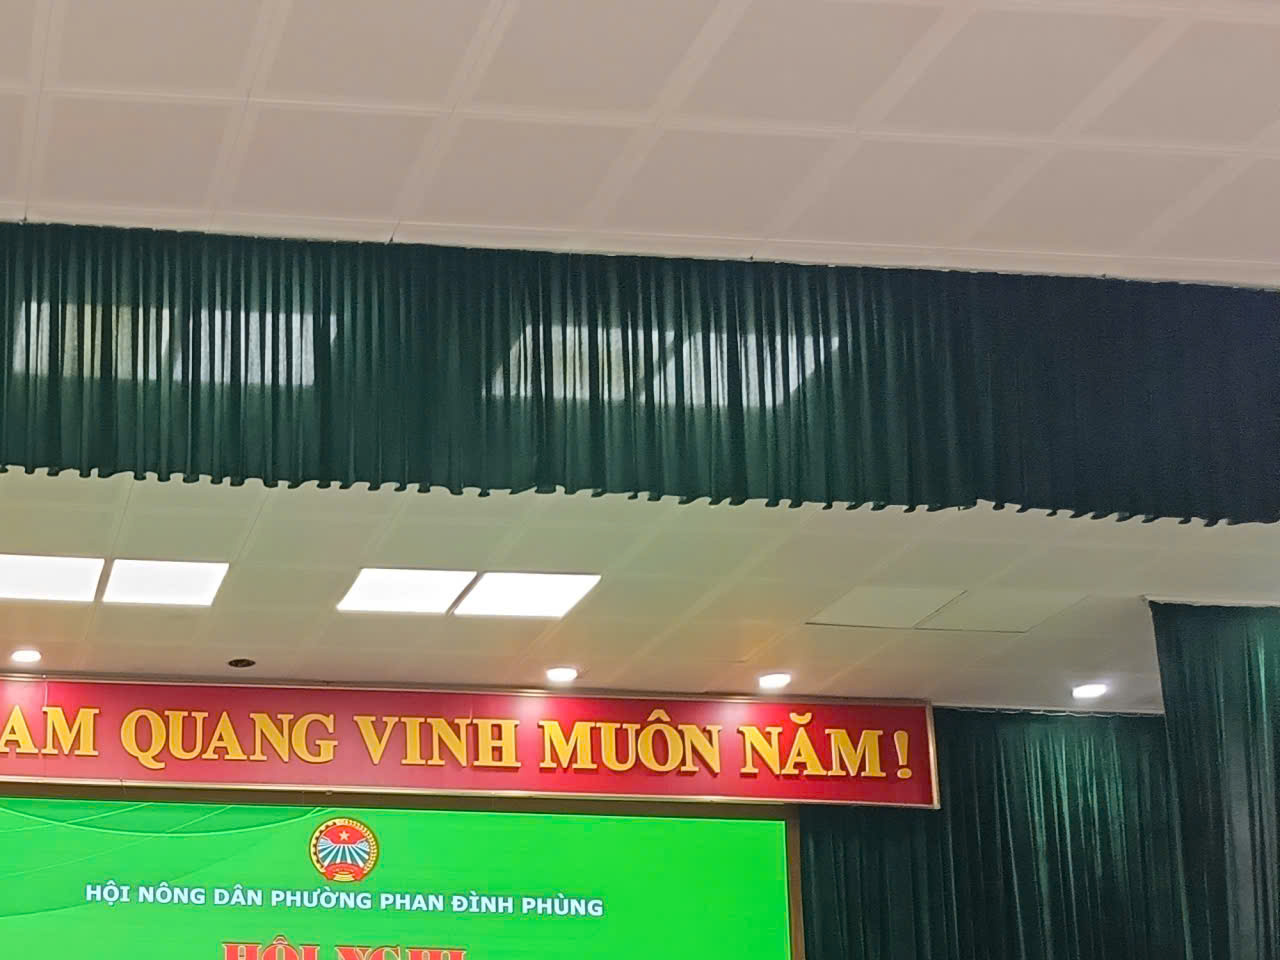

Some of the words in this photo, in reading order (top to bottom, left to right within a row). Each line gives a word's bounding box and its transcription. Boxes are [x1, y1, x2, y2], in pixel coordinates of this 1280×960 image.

[120, 708, 338, 770] QUANG
[353, 714, 522, 768] VINH
[538, 709, 721, 774] MUÔN
[85, 880, 130, 906] HỘI
[138, 882, 205, 905] NÔNG
[214, 883, 262, 906] DÂN
[272, 886, 372, 910] PHƯỜNG
[380, 893, 443, 912] PHAN
[451, 890, 514, 914] ĐÌNH
[522, 894, 604, 917] PHÙNG
